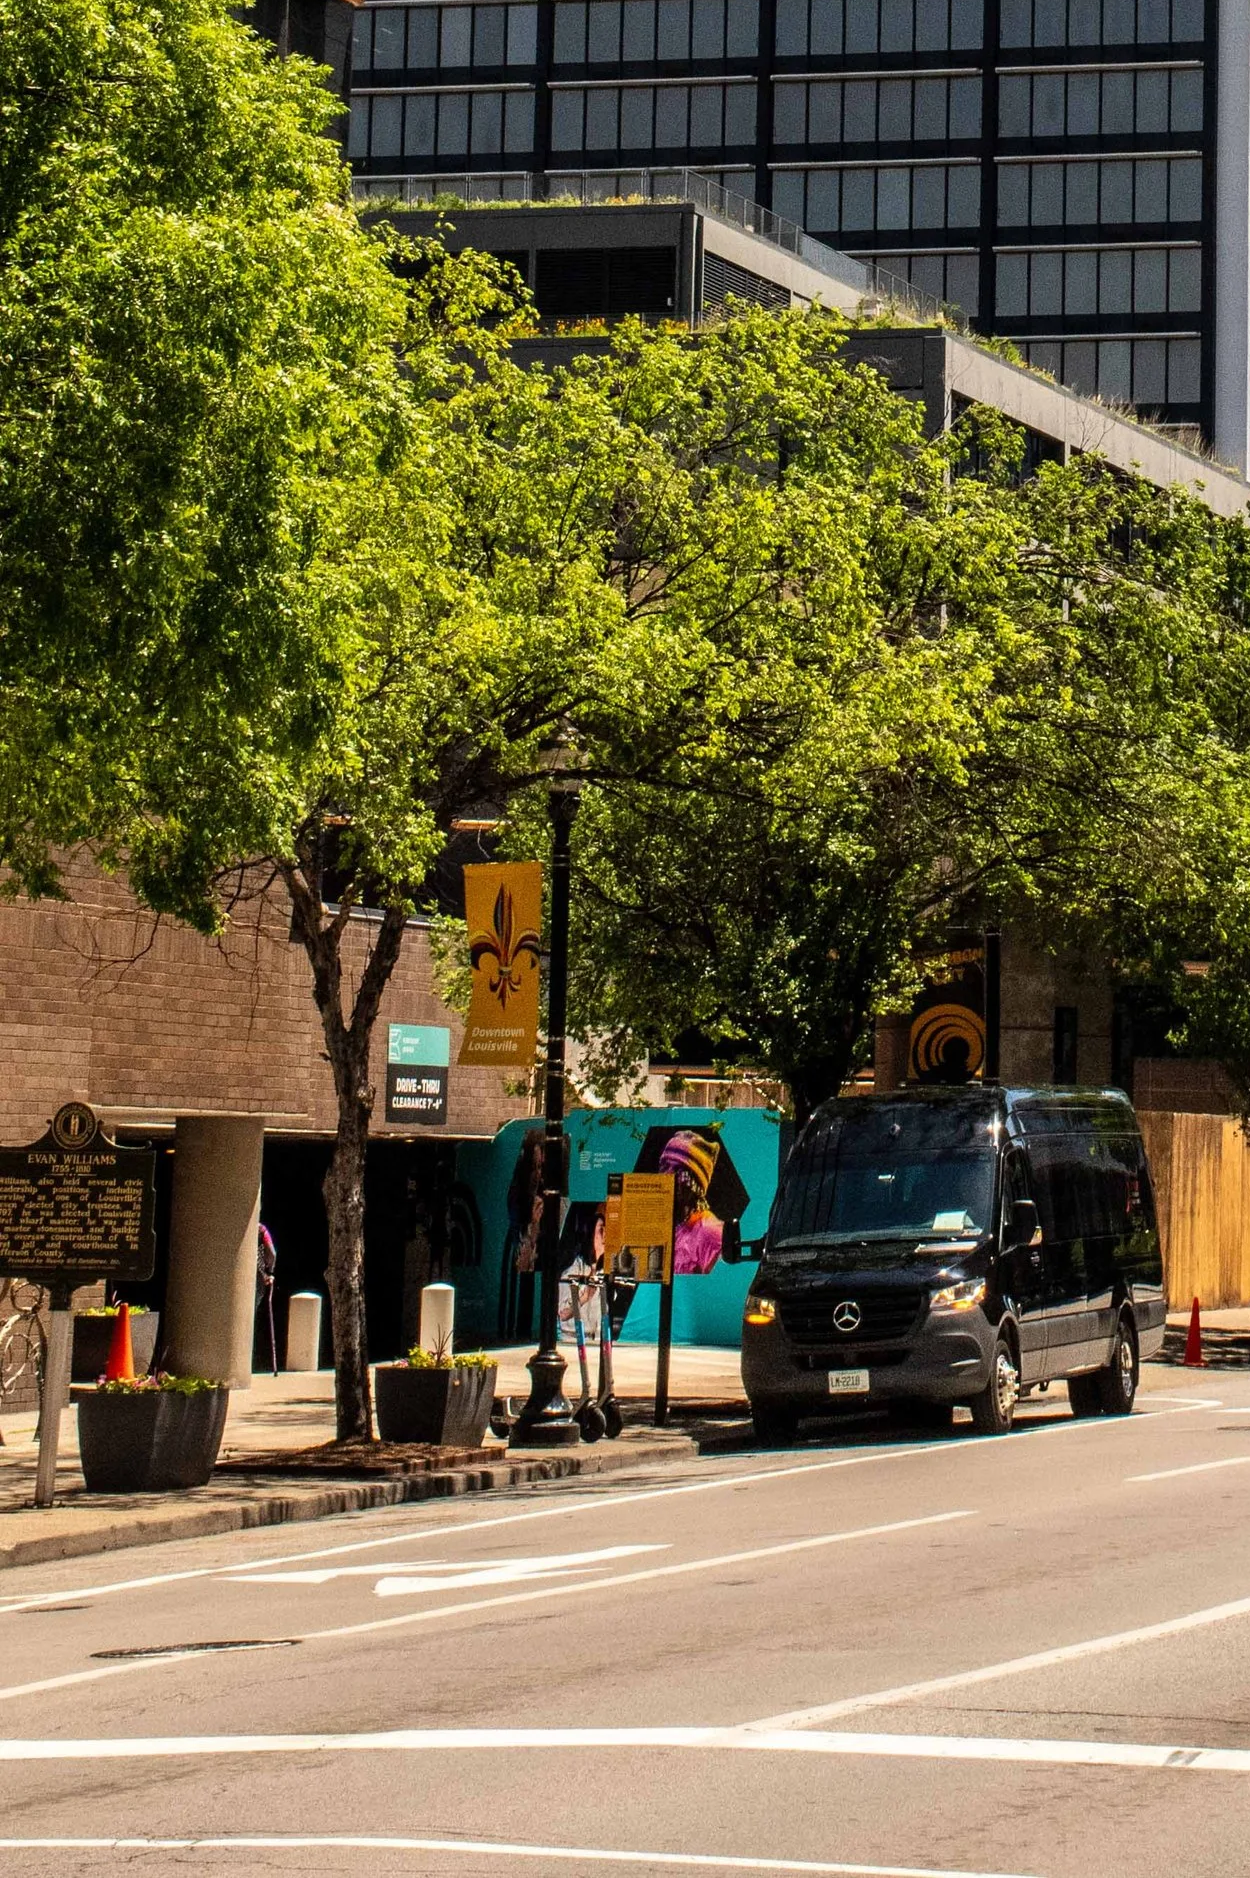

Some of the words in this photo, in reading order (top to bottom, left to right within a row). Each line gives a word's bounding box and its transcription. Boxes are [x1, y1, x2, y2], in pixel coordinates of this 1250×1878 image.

[472, 1027, 525, 1037] Downtown
[468, 1040, 518, 1051] Louisville
[392, 1097, 427, 1109] CLEARANCE
[28, 1154, 57, 1164] EVAN
[63, 1155, 117, 1165] WILLIAMS
[38, 1177, 54, 1185] also
[63, 1177, 80, 1185] held
[88, 1178, 117, 1186] several
[124, 1178, 144, 1186] civic
[0, 1186, 38, 1195] eadership
[52, 1186, 89, 1195] positions
[106, 1186, 143, 1196] including
[0, 1194, 25, 1202] erving
[79, 1194, 89, 1202] of
[24, 1201, 54, 1209] elected
[61, 1202, 78, 1211] city
[132, 1202, 142, 1211] In
[22, 1208, 32, 1217] he
[60, 1209, 91, 1217] elected
[98, 1209, 141, 1218] Louisville's
[19, 1217, 44, 1225] wharf
[86, 1217, 96, 1226] he
[124, 1218, 141, 1226] also
[37, 1225, 83, 1233] stonemason
[89, 1225, 105, 1233] and
[111, 1225, 140, 1234] builder
[0, 1232, 9, 1240] ho
[50, 1233, 103, 1241] construction
[108, 1233, 118, 1242] of
[125, 1234, 139, 1242] the
[0, 1240, 10, 1248] rst
[21, 1240, 36, 1250] jail
[45, 1240, 61, 1249] and
[72, 1241, 119, 1250] courthouse
[130, 1242, 139, 1250] in
[0, 1248, 30, 1256] fferson
[34, 1248, 66, 1258] County.
